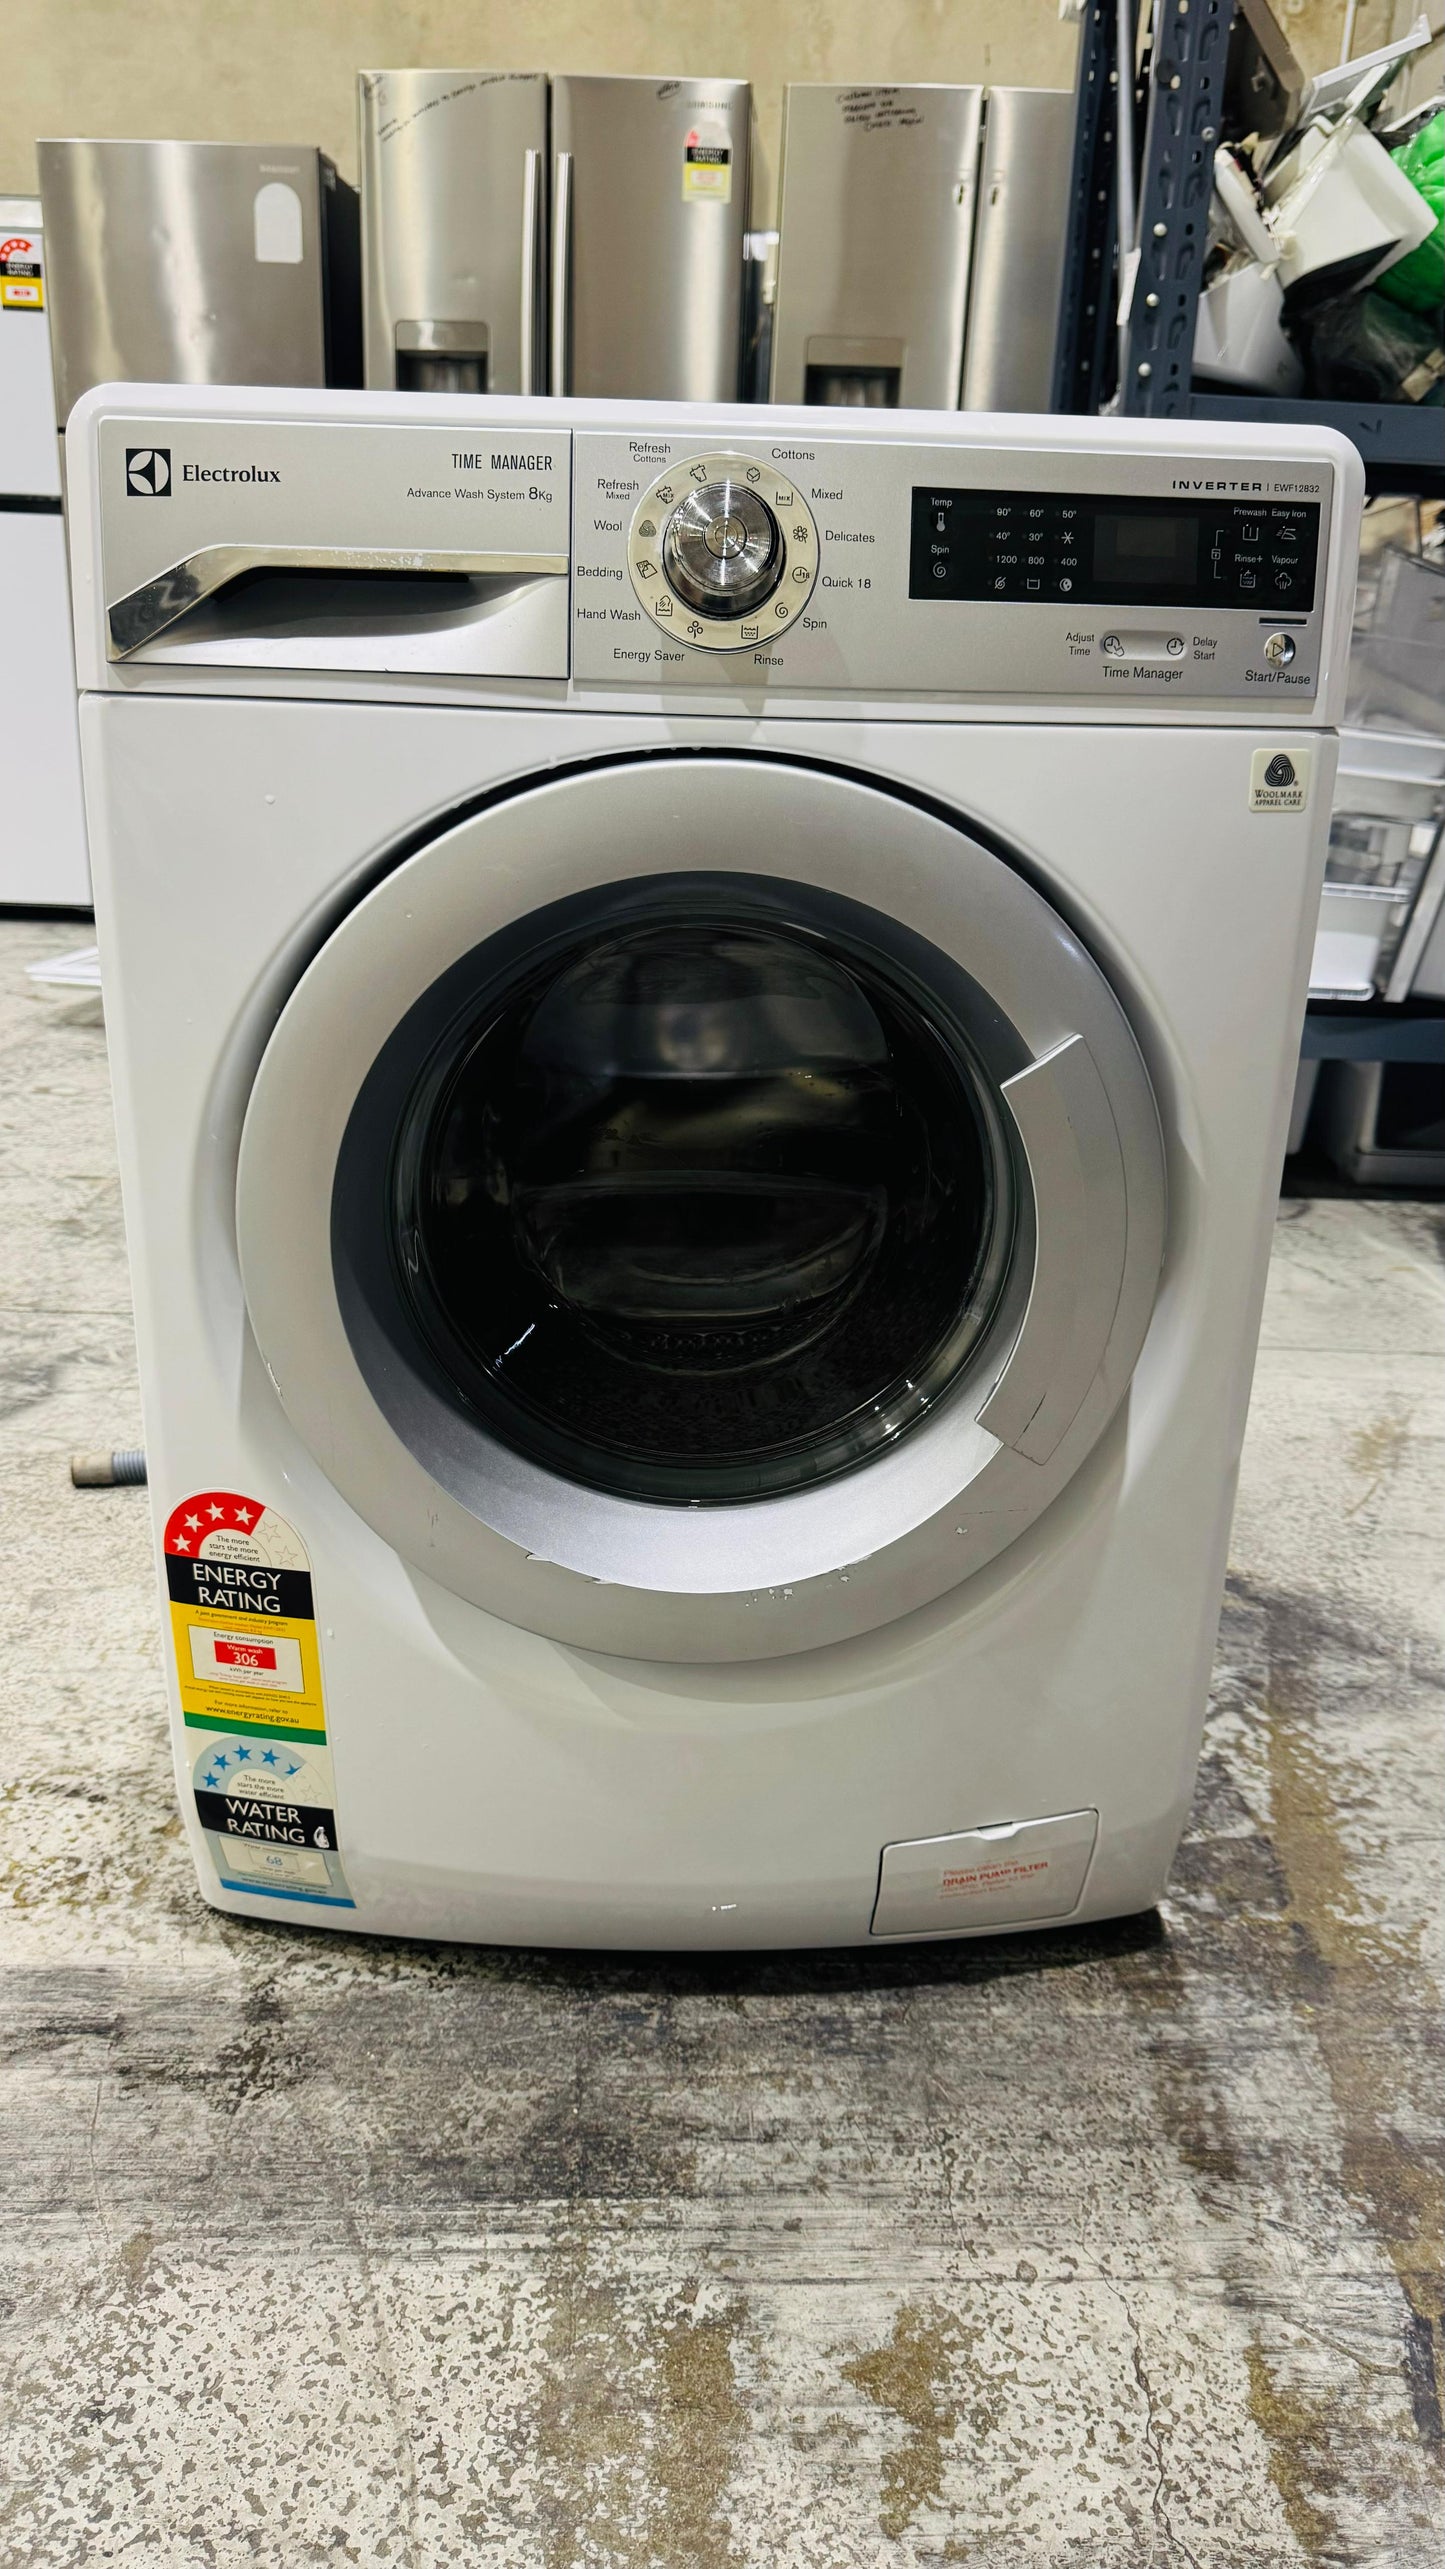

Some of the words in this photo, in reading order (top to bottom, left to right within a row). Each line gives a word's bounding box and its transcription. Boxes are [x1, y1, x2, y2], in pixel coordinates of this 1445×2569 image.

[629, 442, 671, 453] Refresh
[633, 454, 667, 463] Cottons
[771, 448, 815, 460] Cottons
[451, 454, 482, 469] TIME
[491, 454, 553, 471] MANAGER
[183, 465, 281, 482] Electrolux
[597, 479, 639, 490] Refresh
[1172, 480, 1262, 491] INVERTER
[1274, 484, 1320, 493] EWF12832
[407, 488, 451, 498] Advance
[454, 488, 484, 499] Wash
[487, 489, 525, 502] System
[528, 487, 553, 503] 8Kg
[606, 491, 630, 500] Mixed
[811, 488, 843, 500] Mixed
[930, 497, 953, 508] Temp
[1233, 507, 1267, 516] Prewash
[1271, 508, 1290, 519] Easy
[1291, 509, 1307, 518] Iron
[594, 520, 622, 531] Wool
[825, 530, 875, 543] Delicates
[930, 545, 950, 556] Spin
[996, 555, 1018, 564] 1200
[1028, 556, 1045, 565] 800
[1061, 557, 1078, 566] 400
[1234, 553, 1263, 563] Rinse+
[1271, 555, 1299, 565] Vapour
[577, 566, 623, 580] Bedding
[822, 576, 853, 588] Quick
[858, 579, 871, 588] 18
[577, 608, 607, 619] Hand
[610, 609, 641, 620] Wash
[802, 617, 827, 630] Spin
[1065, 633, 1095, 643] Adjust
[1193, 637, 1218, 649] Delay
[613, 648, 651, 662] Energy
[654, 650, 685, 661] Saver
[1069, 646, 1091, 656] Time
[1193, 651, 1215, 661] Start
[754, 654, 784, 665] Rinse
[1102, 666, 1129, 678] Time
[1133, 667, 1183, 682] Manager
[1244, 670, 1311, 685] Start/Pause
[1254, 789, 1303, 798] WOOLMARK
[216, 1535, 230, 1543] The
[231, 1538, 250, 1546] more
[209, 1551, 232, 1560] energy
[233, 1554, 260, 1563] efficient
[240, 1547, 259, 1555] more
[192, 1563, 281, 1590] ENERGY
[198, 1586, 281, 1613] RATING
[213, 1631, 234, 1641] Energy
[235, 1634, 274, 1645] consumption
[226, 1644, 247, 1652] Warm
[248, 1647, 263, 1655] wash
[233, 1652, 259, 1667] 306
[206, 1706, 299, 1724] www.energyrating.gov.au
[243, 1774, 256, 1782] The
[258, 1777, 276, 1785] more
[258, 1791, 285, 1800] efficient
[225, 1798, 302, 1824] WATER
[226, 1818, 305, 1844] RATING
[943, 1875, 977, 1887] DRAIN
[979, 1868, 1012, 1881] PUMP
[1013, 1861, 1048, 1874] FILTER
